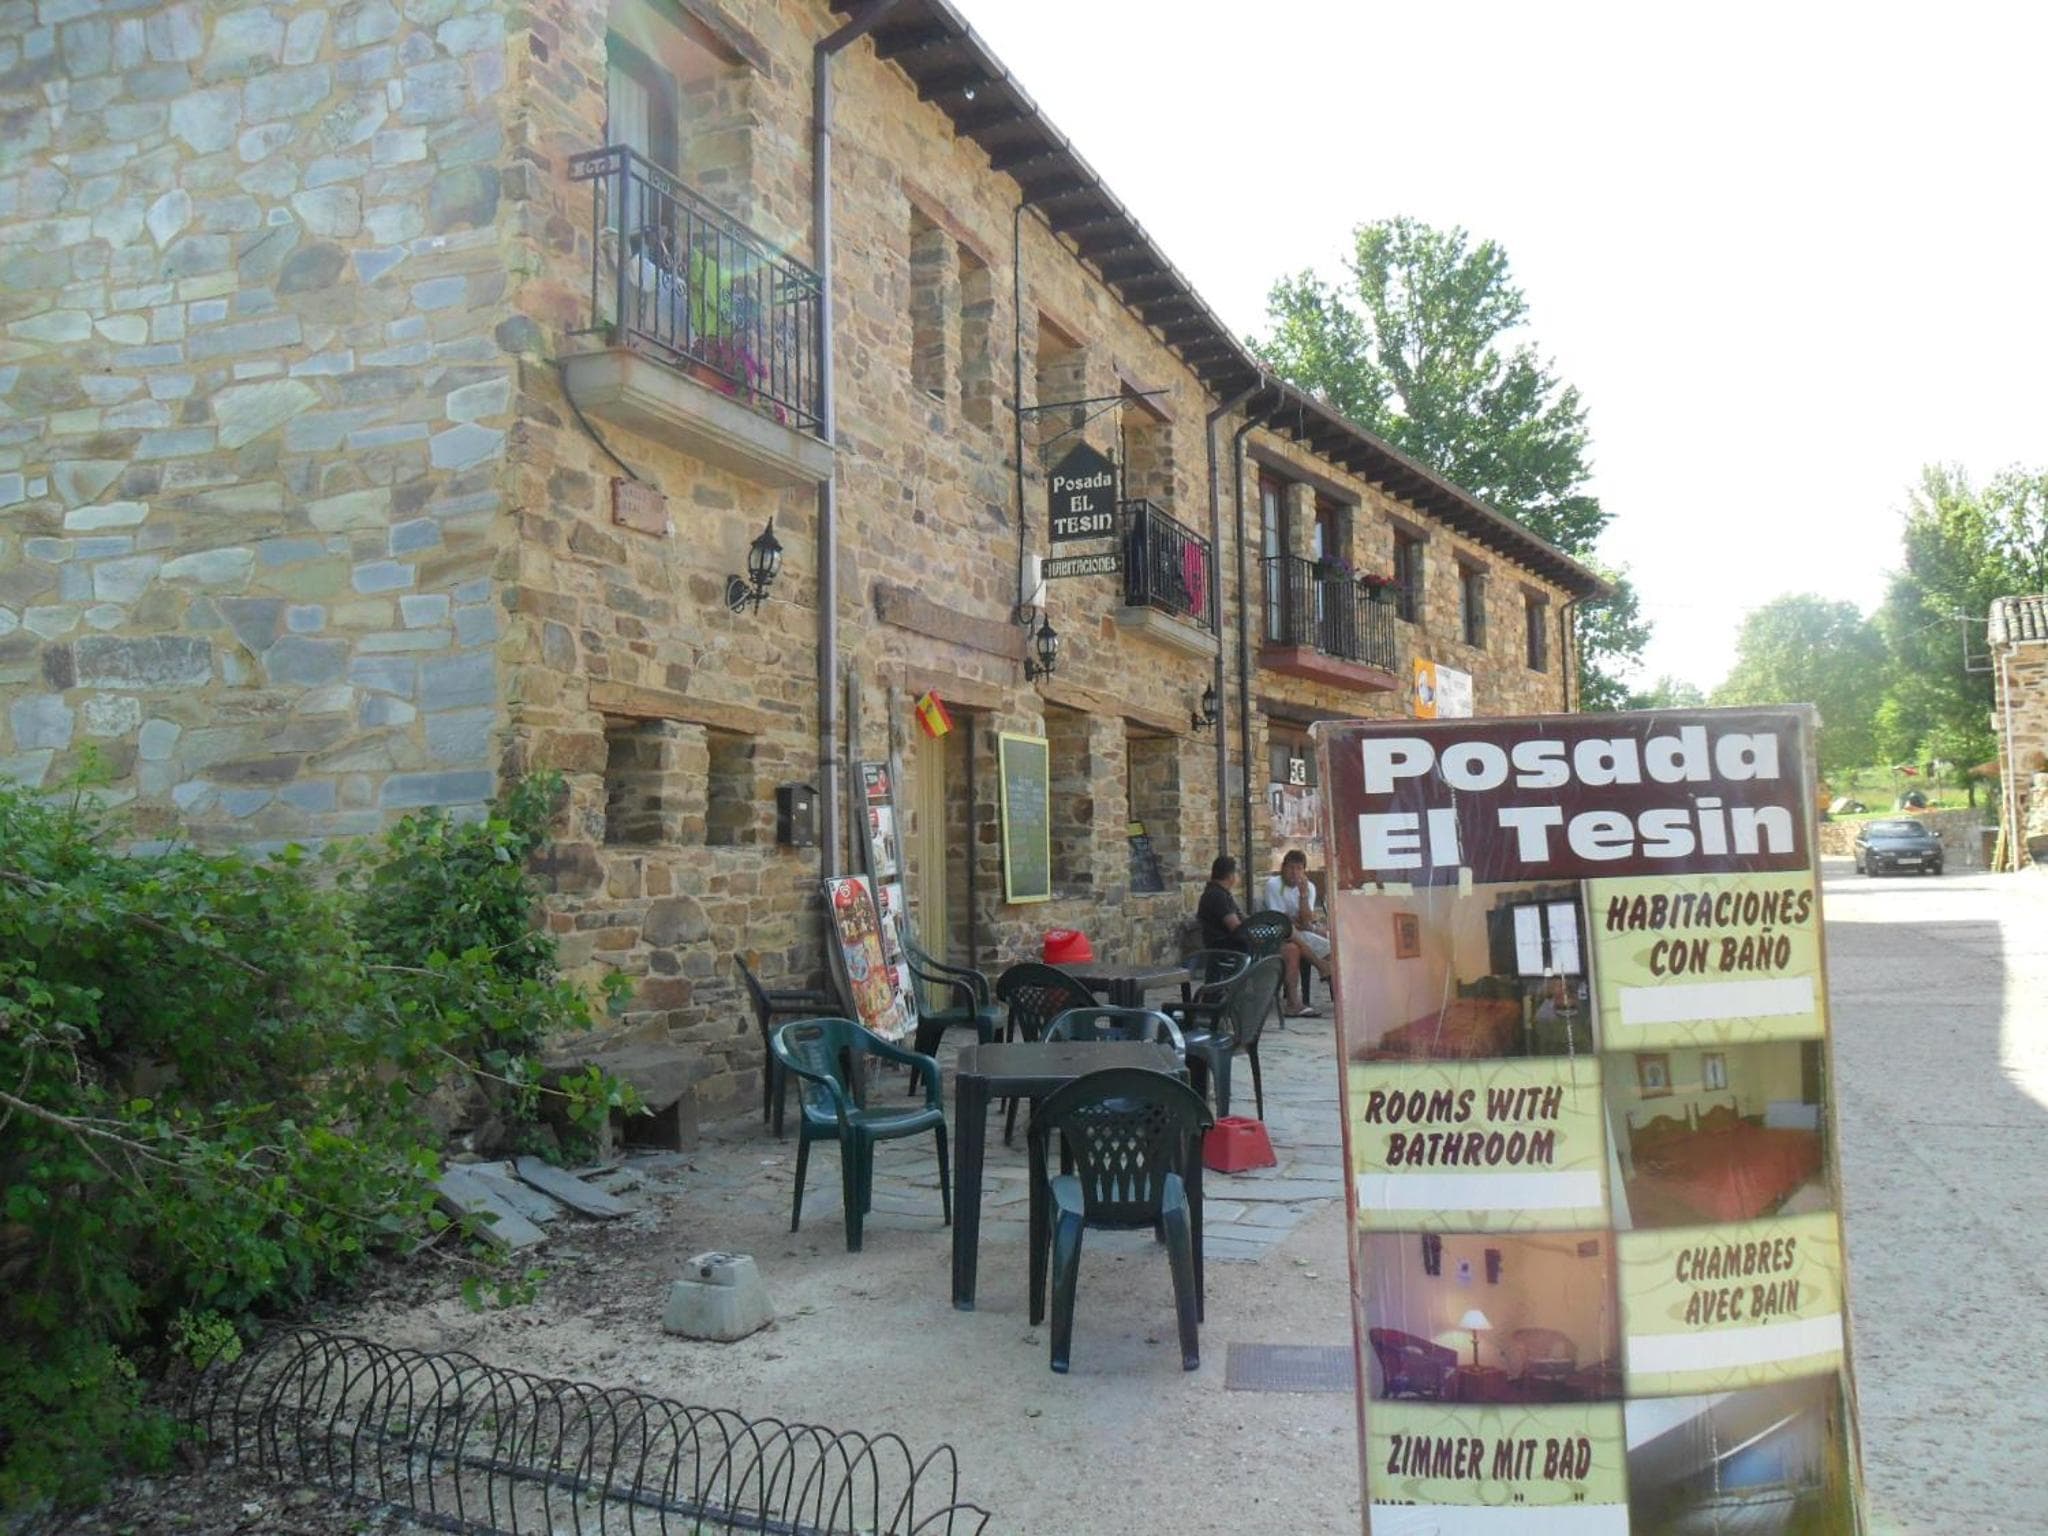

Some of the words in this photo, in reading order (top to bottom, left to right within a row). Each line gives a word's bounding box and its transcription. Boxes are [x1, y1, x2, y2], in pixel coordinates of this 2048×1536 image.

[1053, 471, 1112, 493] Posada
[1071, 495, 1094, 512] EL
[1361, 726, 1781, 794] Posada
[1358, 807, 1461, 870] El
[1498, 797, 1795, 863] Tesin
[1606, 889, 1813, 931] HABITACIONES
[1650, 938, 1710, 976] CON
[1719, 927, 1791, 972] BAÑO
[1365, 1088, 1475, 1124] ROOMS
[1487, 1085, 1563, 1122] WITH
[1386, 1129, 1556, 1166] BATHROOM
[1676, 1237, 1796, 1283] CHAMBRES
[1685, 1287, 1744, 1325] AVEC
[1751, 1279, 1800, 1318] BAIN
[1387, 1434, 1484, 1480] ZIMMER
[1492, 1437, 1537, 1480] MIT
[1543, 1437, 1592, 1480] BAD
